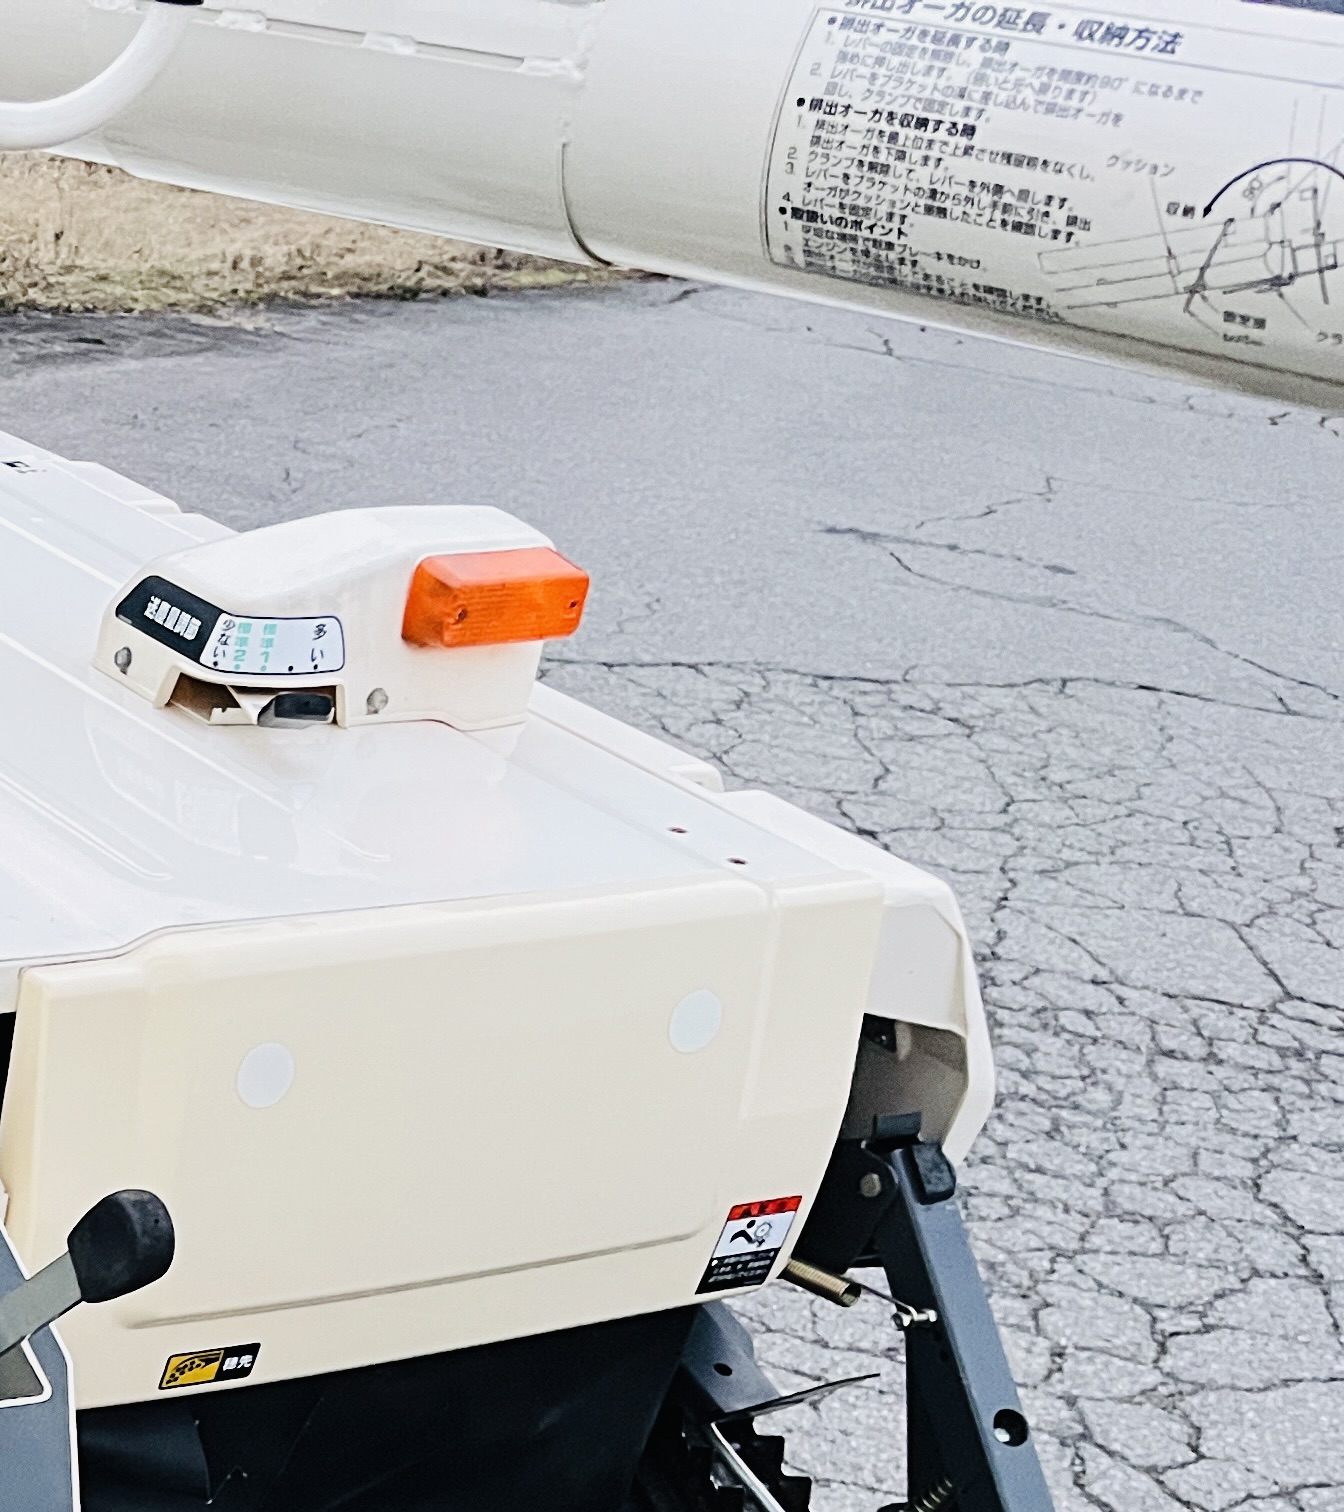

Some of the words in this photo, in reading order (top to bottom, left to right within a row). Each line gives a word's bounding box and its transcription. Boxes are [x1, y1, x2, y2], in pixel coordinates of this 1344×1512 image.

[212, 618, 235, 658] 少ない
[310, 623, 328, 662] 多い
